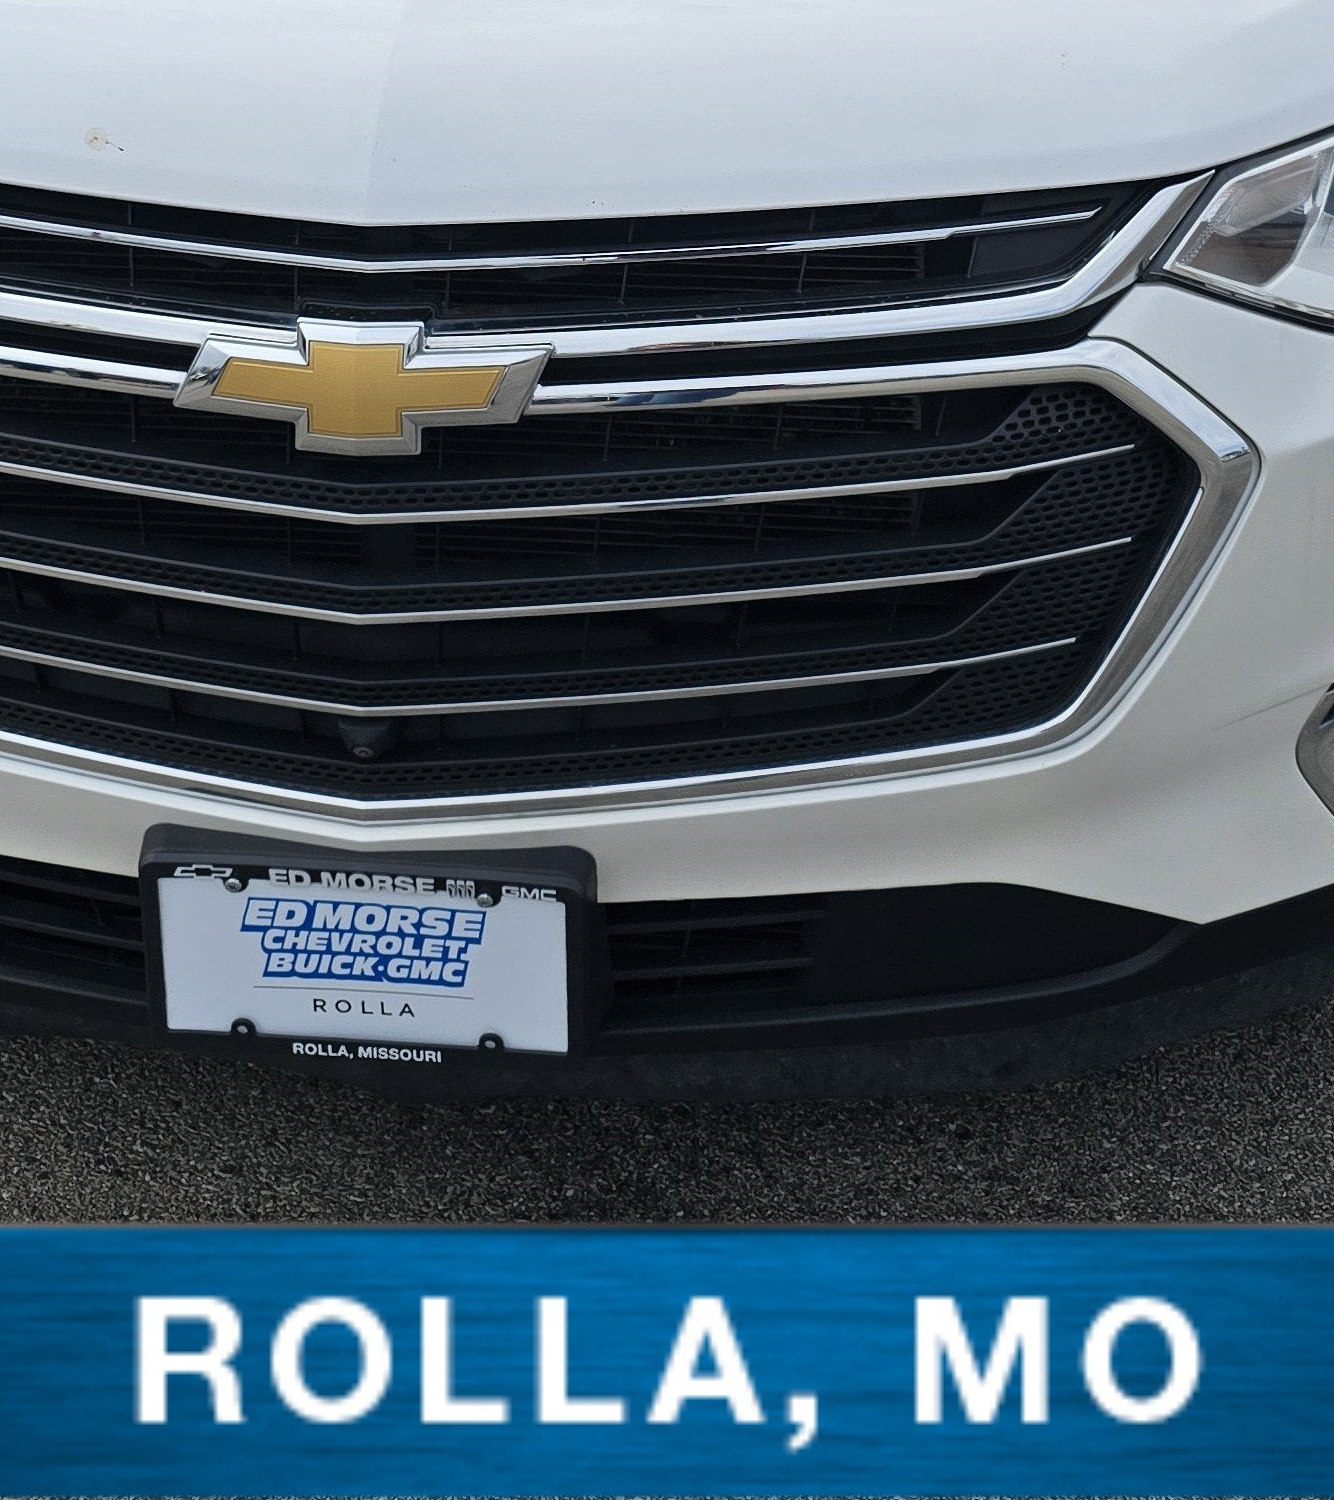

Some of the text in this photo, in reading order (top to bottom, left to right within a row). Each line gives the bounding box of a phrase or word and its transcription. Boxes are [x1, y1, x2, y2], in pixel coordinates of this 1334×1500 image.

[269, 868, 557, 902] ED MORSE GMC
[244, 900, 486, 939] ED MORSE
[263, 928, 466, 960] CHEVROLET
[313, 998, 415, 1018] ROLLA
[292, 1042, 442, 1063] ROLLA, MISSOURI
